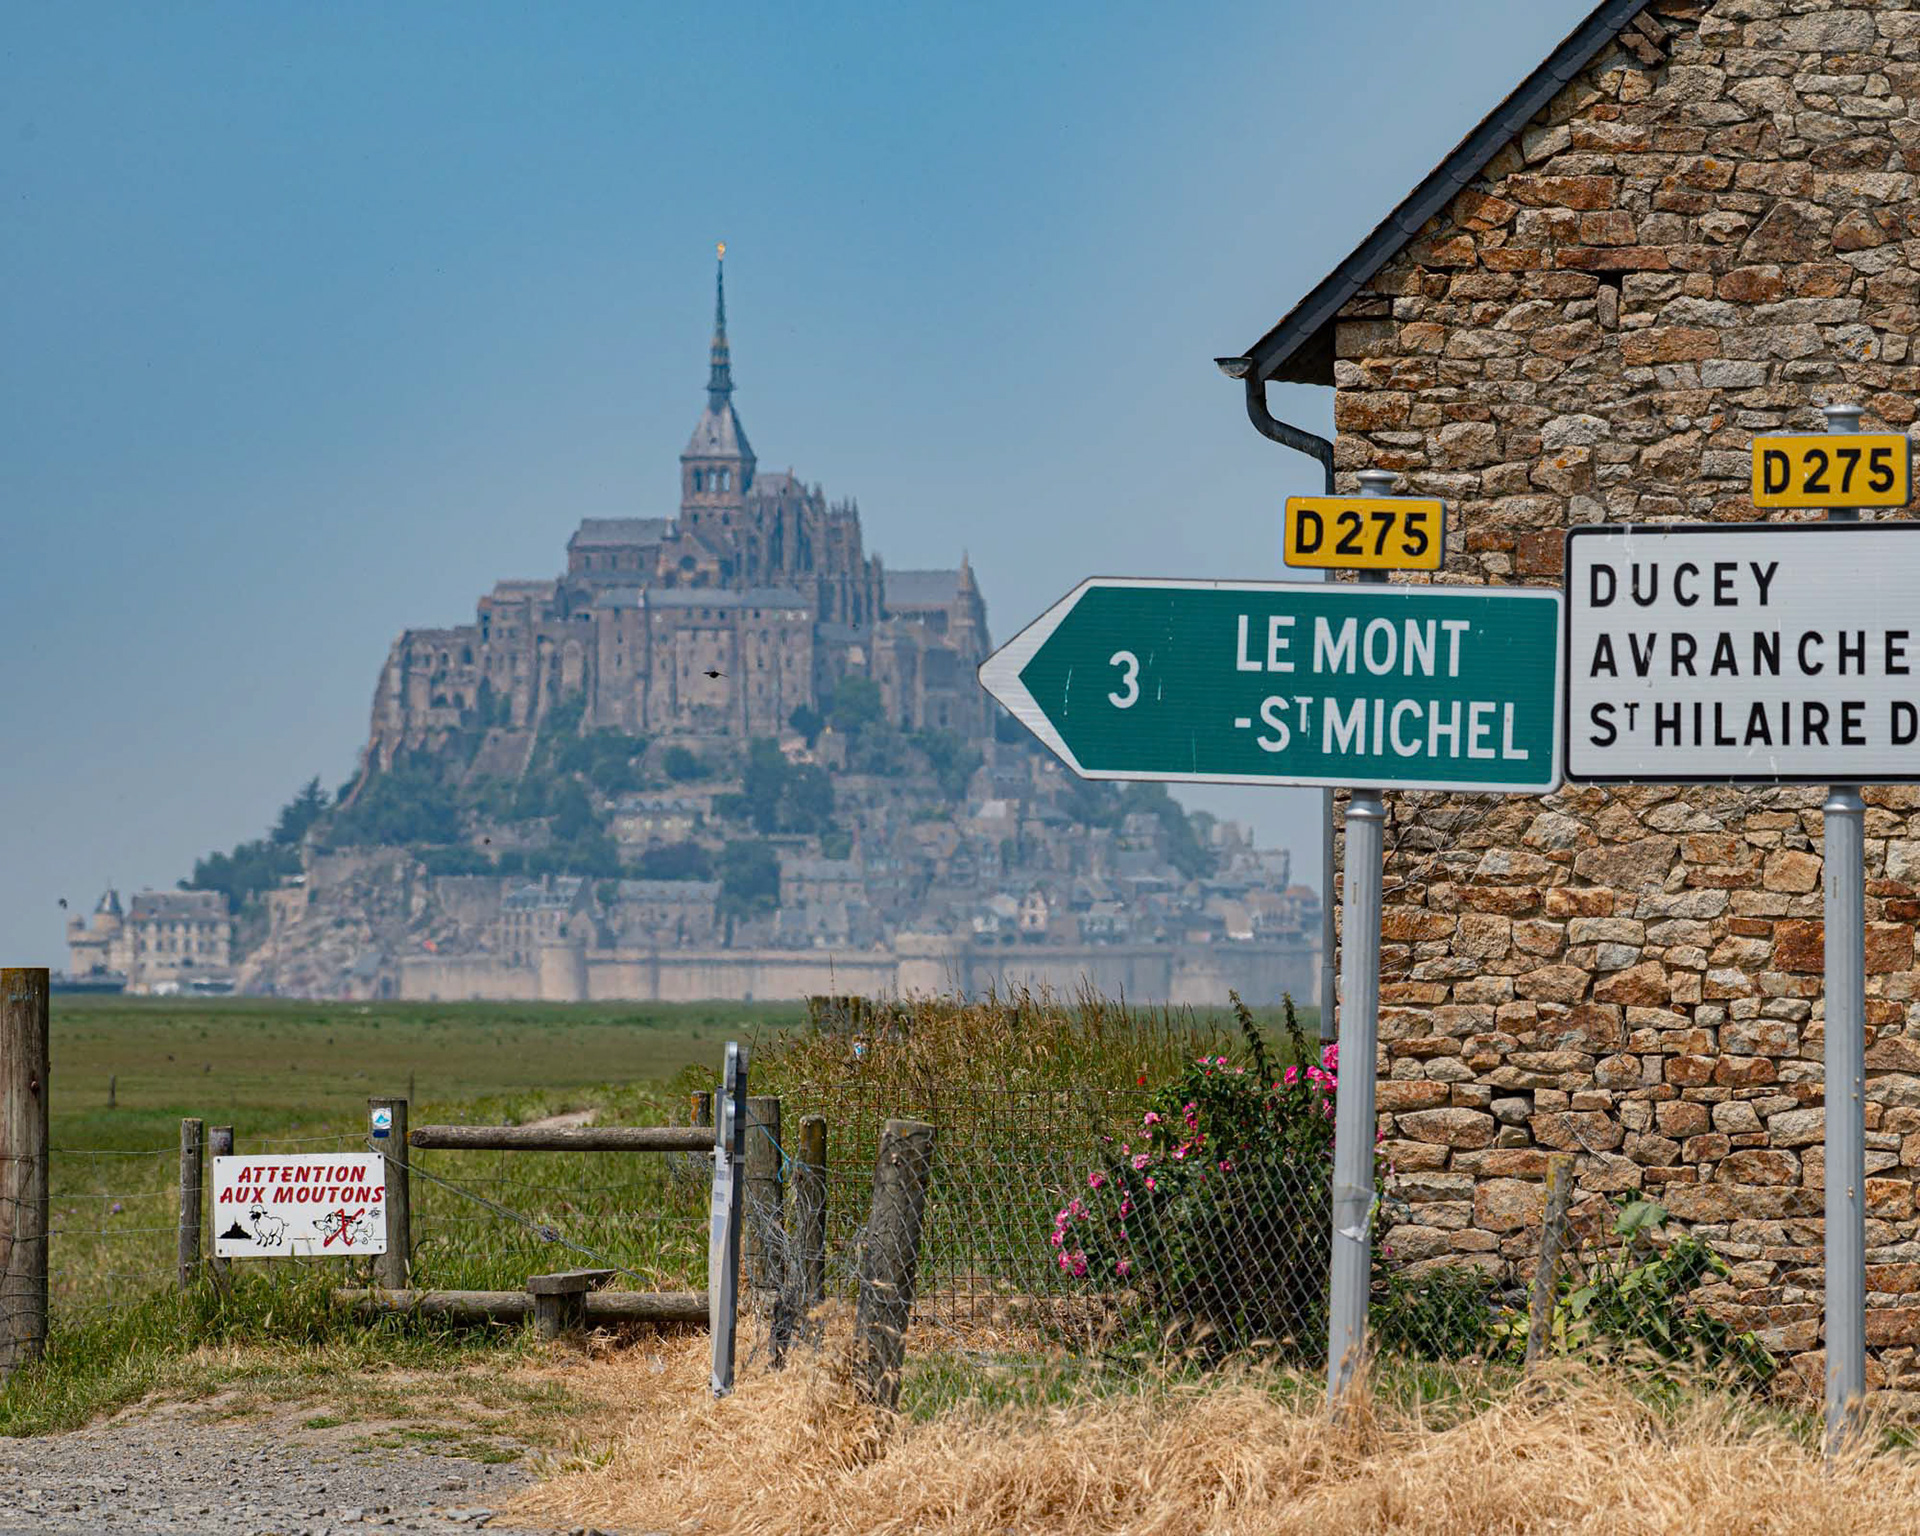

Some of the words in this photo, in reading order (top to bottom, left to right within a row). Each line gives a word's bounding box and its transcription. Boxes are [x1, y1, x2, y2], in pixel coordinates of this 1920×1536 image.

[1589, 561, 1780, 608] DUCEY
[1237, 614, 1295, 672] LE
[1313, 616, 1471, 677] MONT
[1589, 630, 1911, 678] AVRANCHE
[1107, 651, 1140, 709] 3
[219, 1186, 265, 1204] AUX
[272, 1185, 385, 1205] MOUTONS
[237, 1165, 367, 1184] ATTENTION
